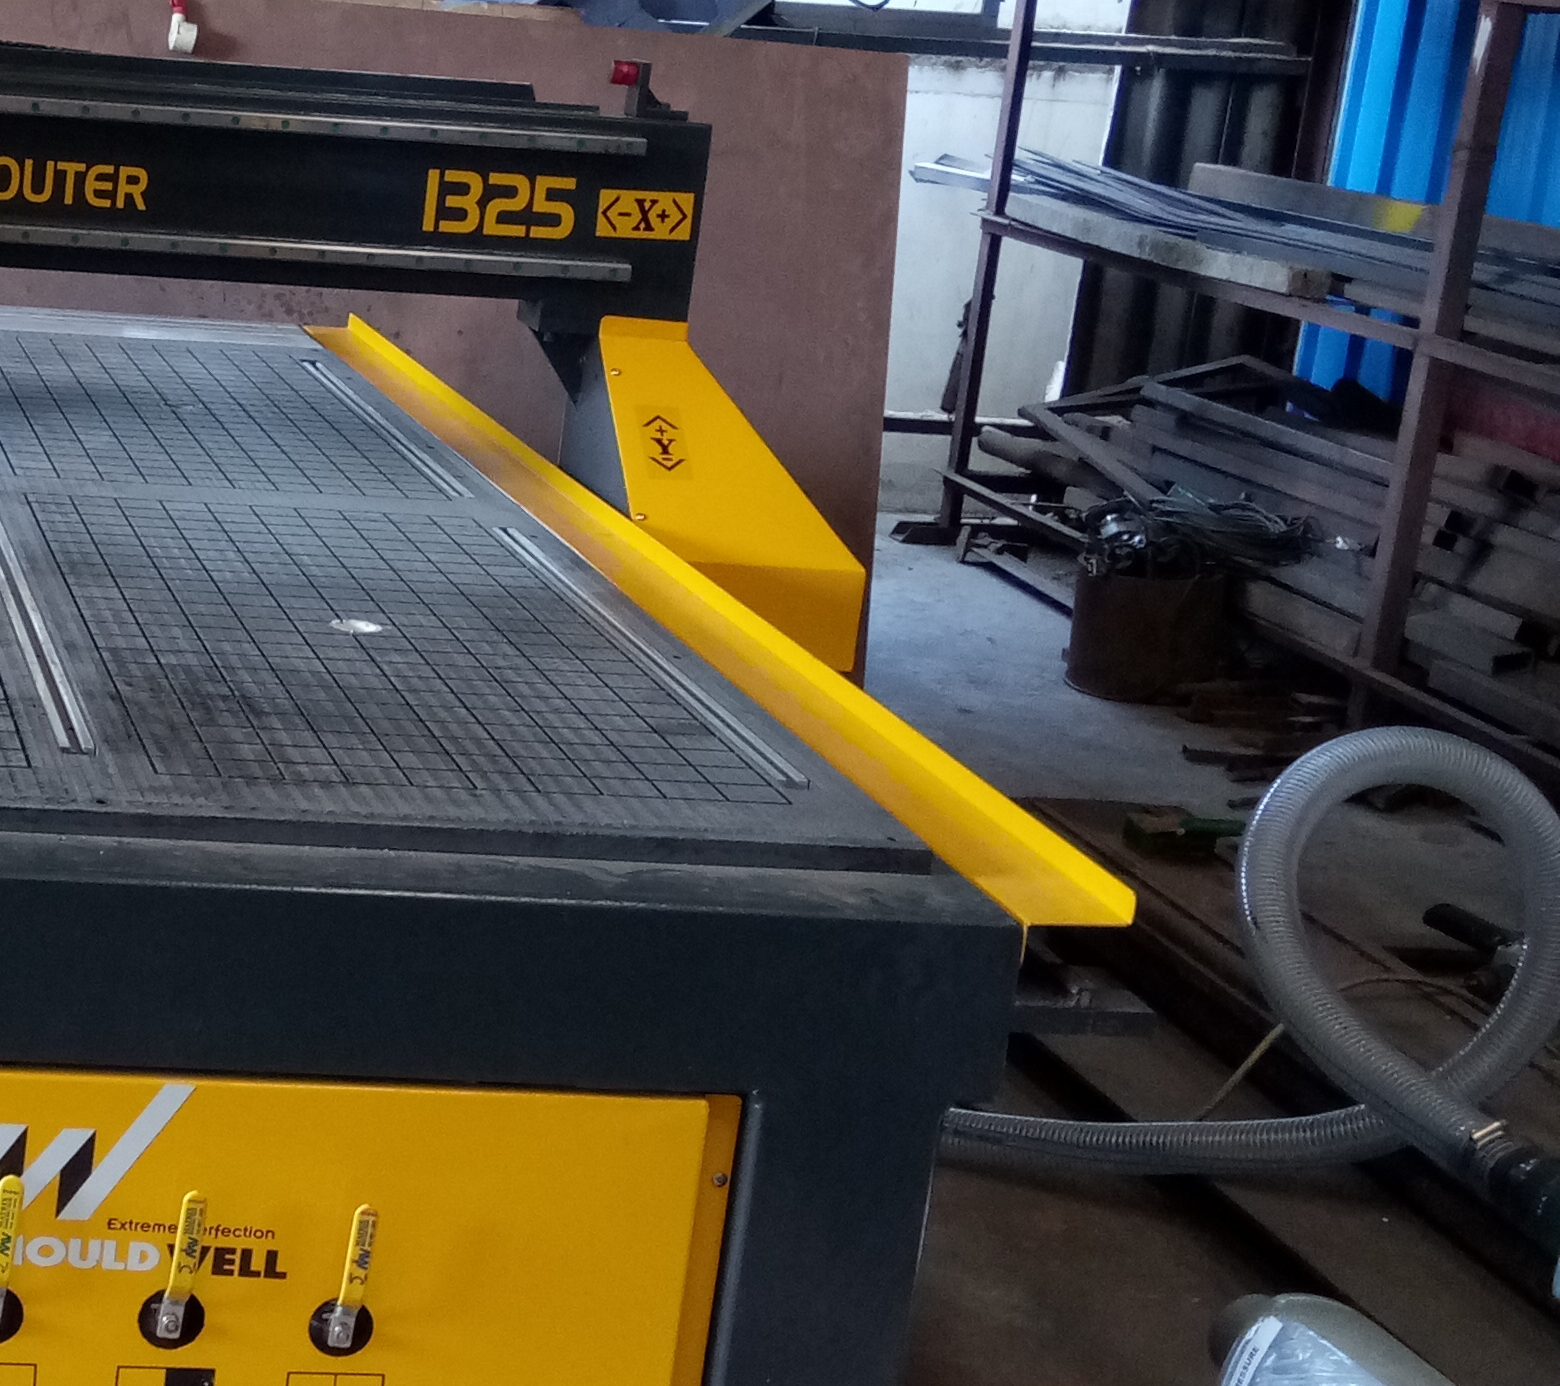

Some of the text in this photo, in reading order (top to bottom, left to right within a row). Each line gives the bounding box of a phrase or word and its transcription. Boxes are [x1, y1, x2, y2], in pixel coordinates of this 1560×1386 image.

[422, 168, 577, 240] 1325
[106, 1217, 177, 1234] Extreme
[203, 1220, 276, 1241] rfection
